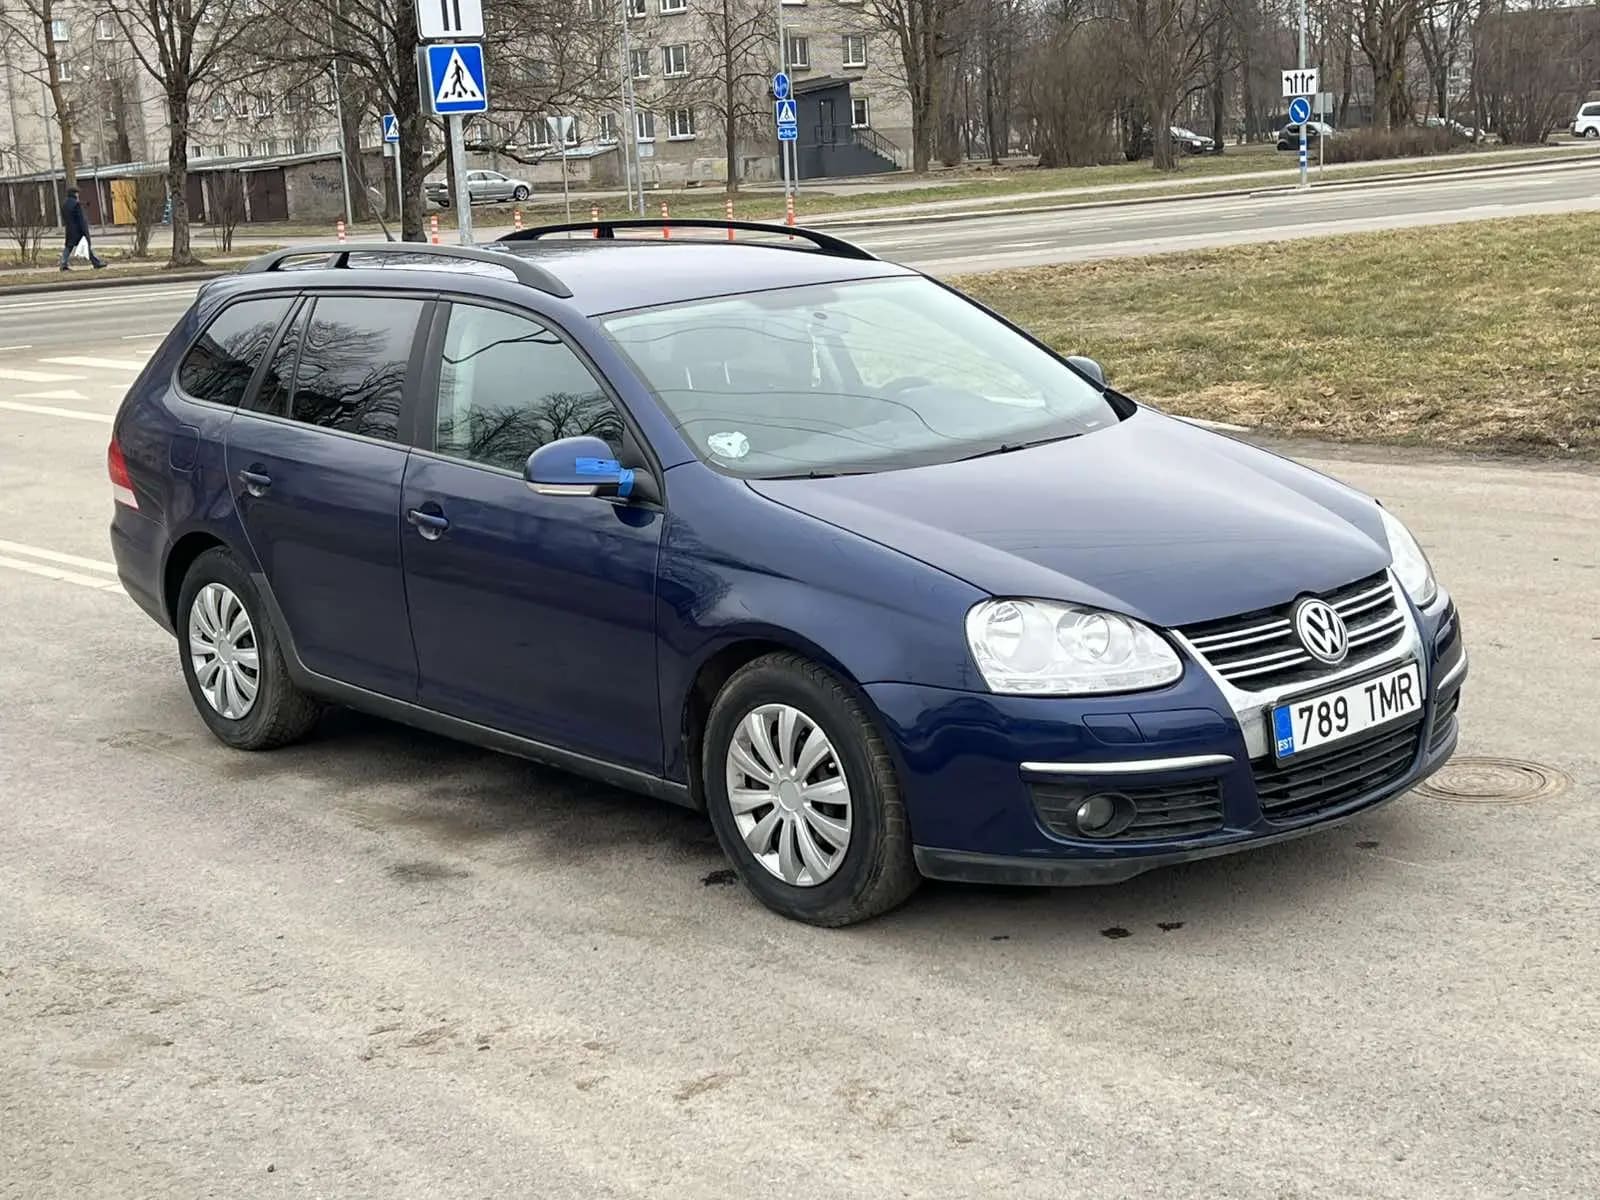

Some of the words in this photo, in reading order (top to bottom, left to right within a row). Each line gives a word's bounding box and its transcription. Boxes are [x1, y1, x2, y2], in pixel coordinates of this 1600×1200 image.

[1302, 604, 1346, 659] VW
[1299, 697, 1349, 745] 789
[1365, 672, 1415, 721] TMR
[1278, 737, 1294, 751] EST
